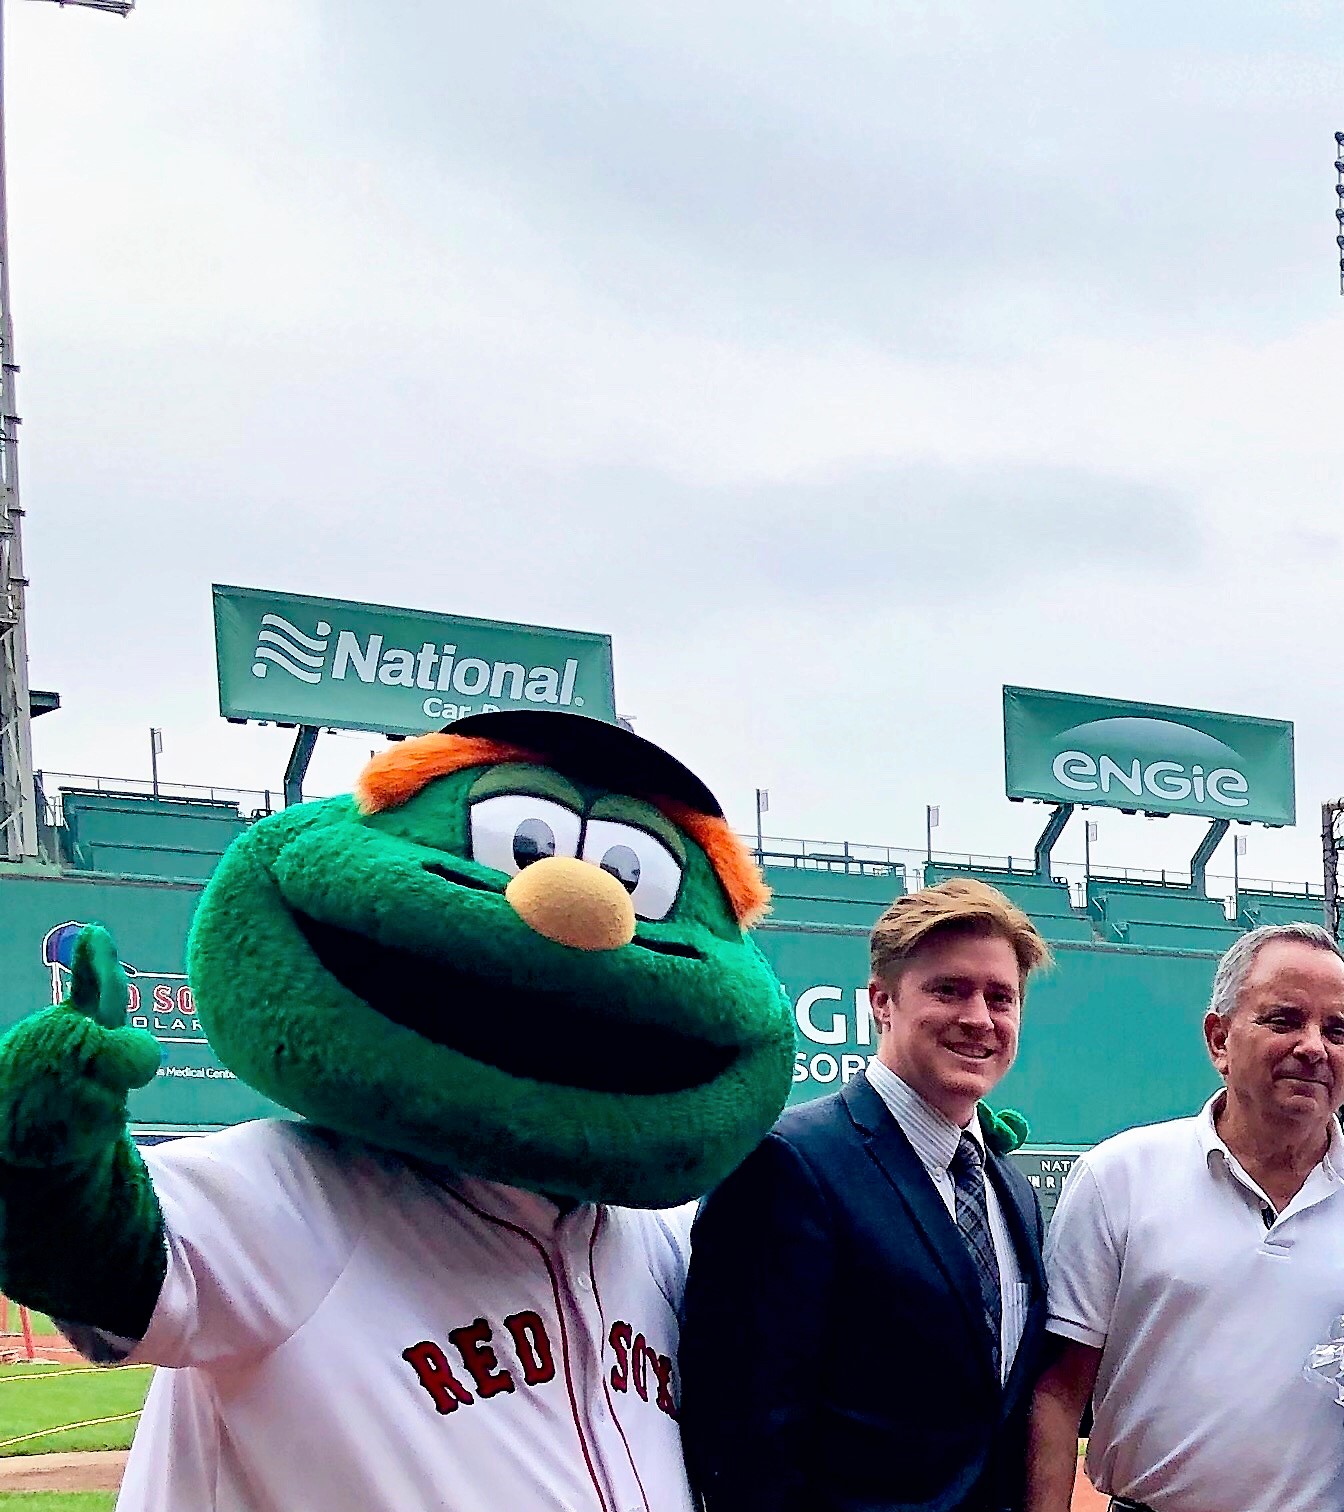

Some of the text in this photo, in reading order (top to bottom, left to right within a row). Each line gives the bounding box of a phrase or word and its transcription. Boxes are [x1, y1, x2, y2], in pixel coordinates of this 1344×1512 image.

[423, 697, 469, 720] Car
[167, 1066, 205, 1078] Medical
[402, 1310, 679, 1420] RED SOX
